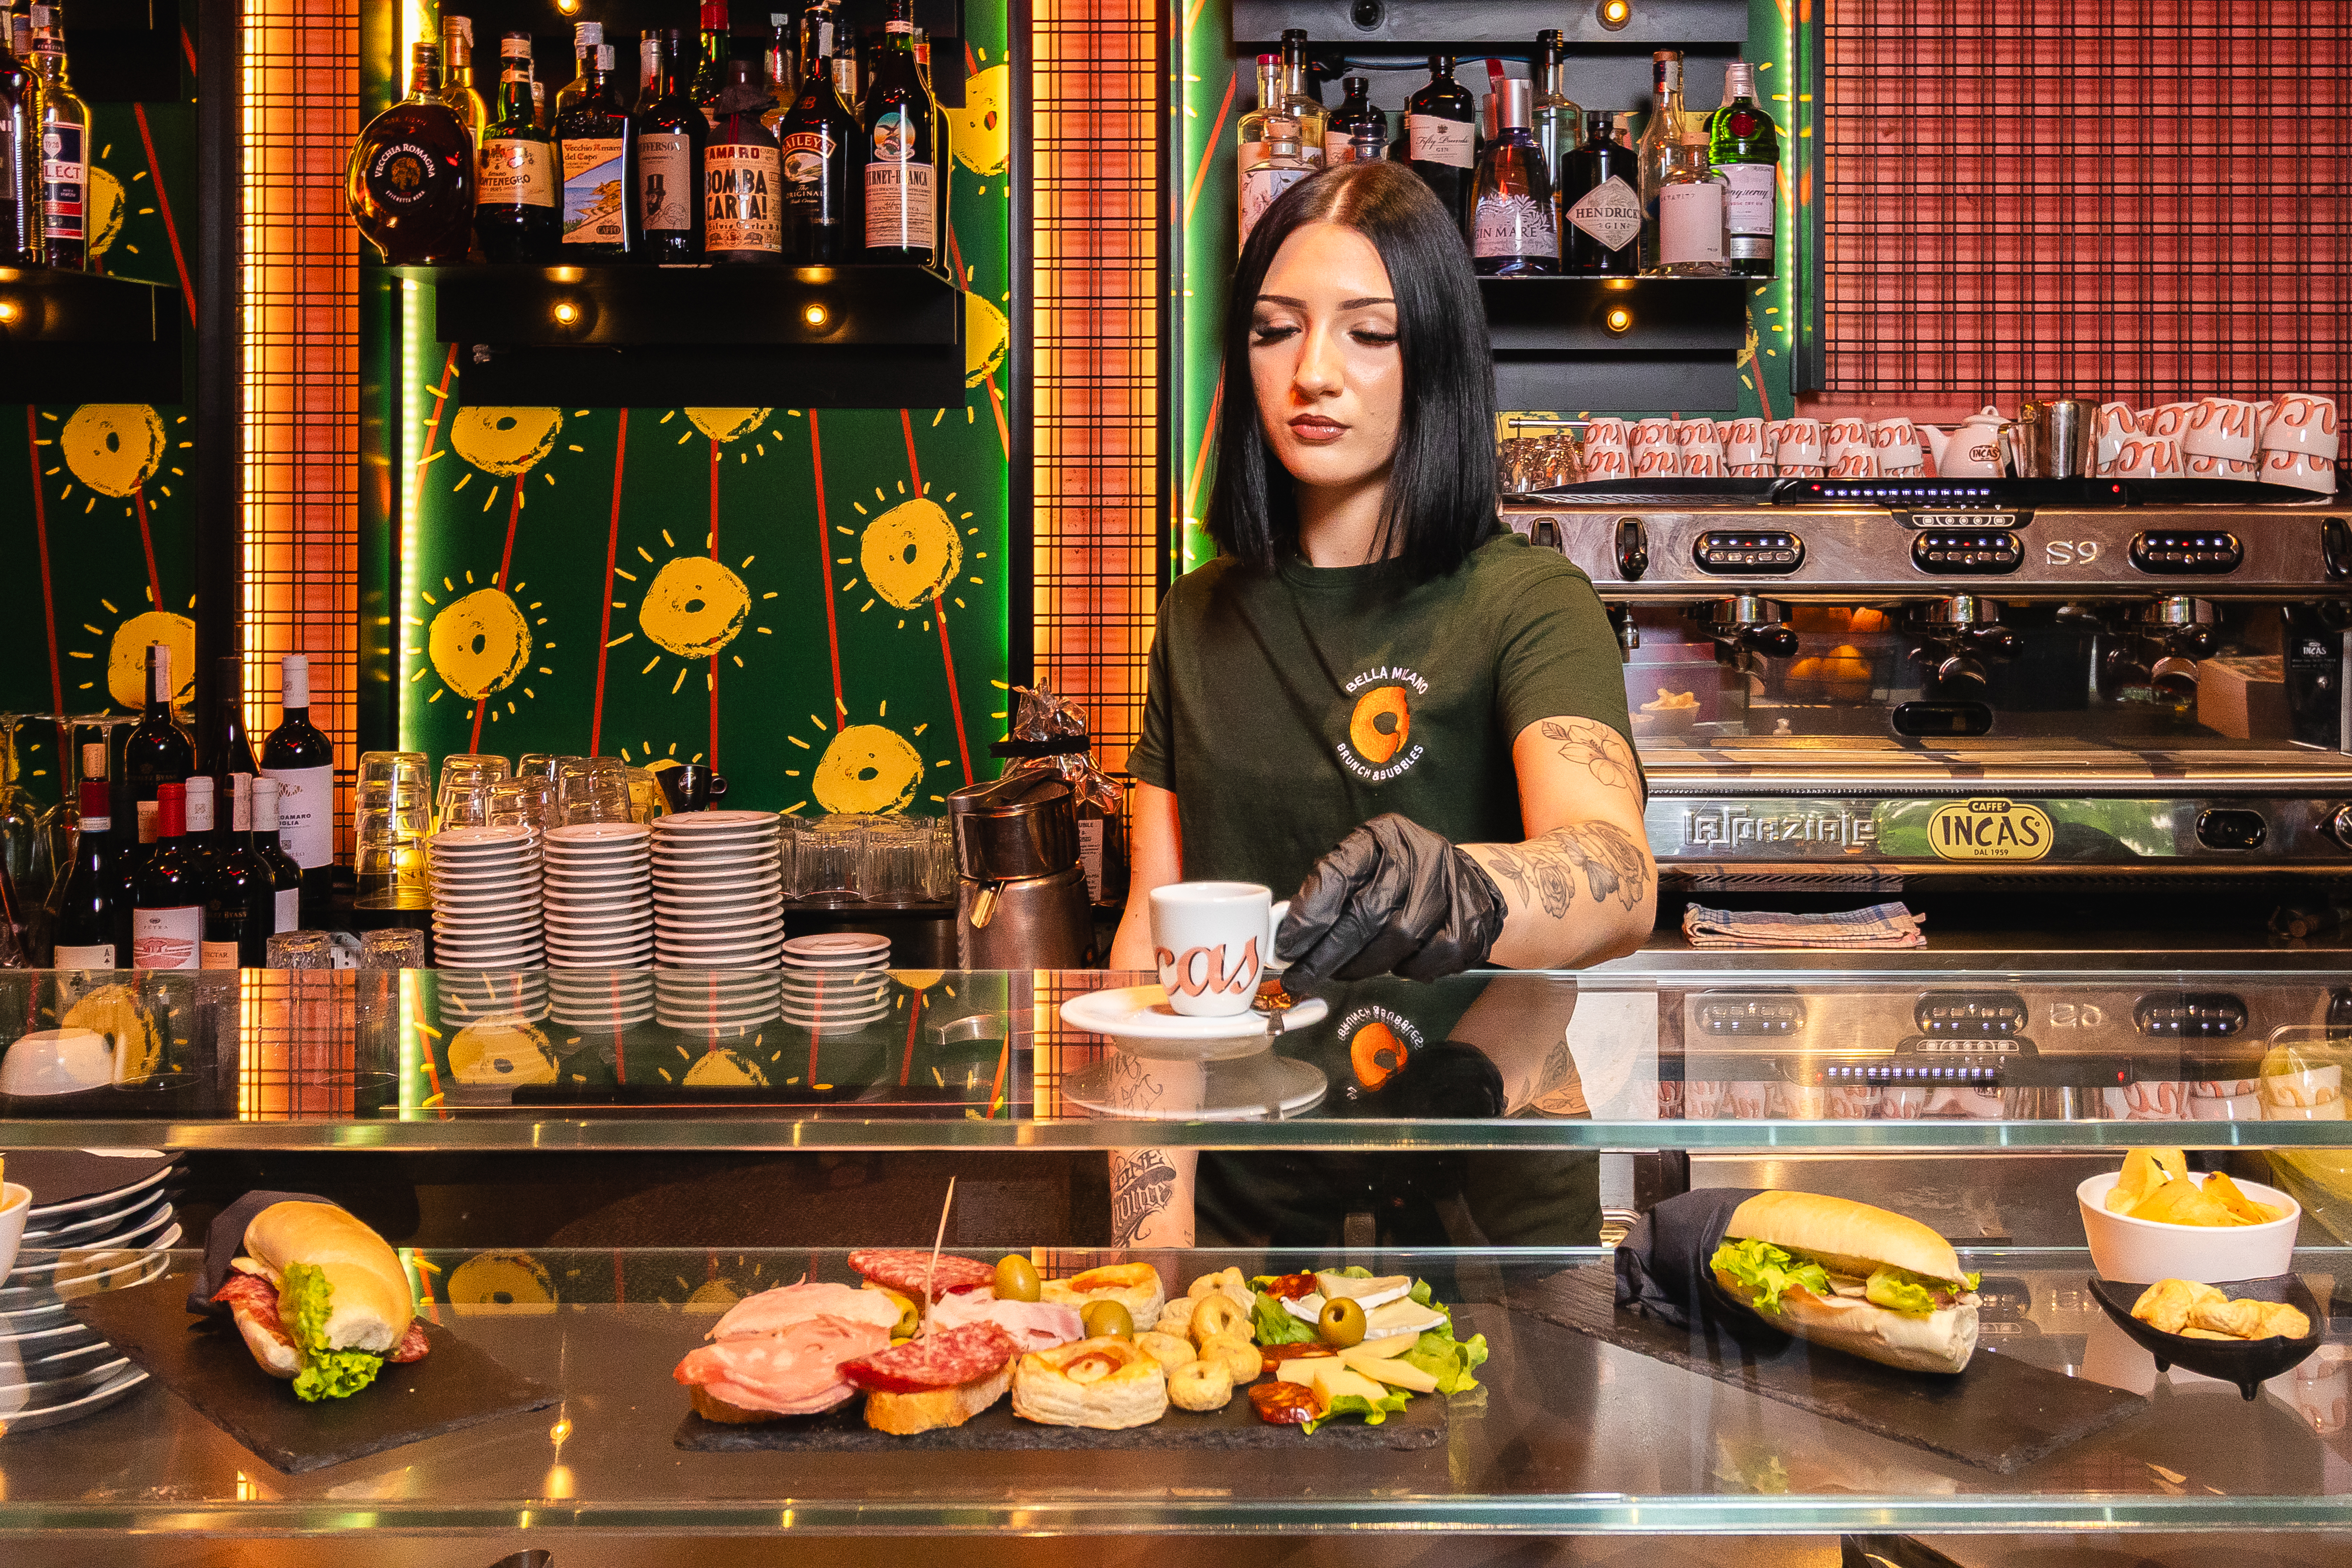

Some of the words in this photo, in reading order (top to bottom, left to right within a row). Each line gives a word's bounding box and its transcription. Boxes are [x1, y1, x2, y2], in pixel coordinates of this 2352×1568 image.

[374, 145, 401, 177] VECCHIA
[402, 143, 436, 178] ROMAGNA
[577, 153, 597, 162] Capo
[709, 146, 760, 159] AMARO
[706, 169, 768, 195] BOMBA
[1474, 228, 1492, 239] GIN
[1495, 227, 1537, 237] MARE
[1973, 449, 1998, 458] INCAS
[2046, 540, 2097, 565] S9
[2303, 647, 2326, 655] INCAS
[1346, 666, 1388, 692] BELLA
[1337, 743, 1371, 778] BRUNCH
[1972, 802, 2006, 811] CAFFE'
[1942, 815, 2040, 847] INCAS
[104, 948, 110, 956] A
[1155, 936, 1259, 997] cas
